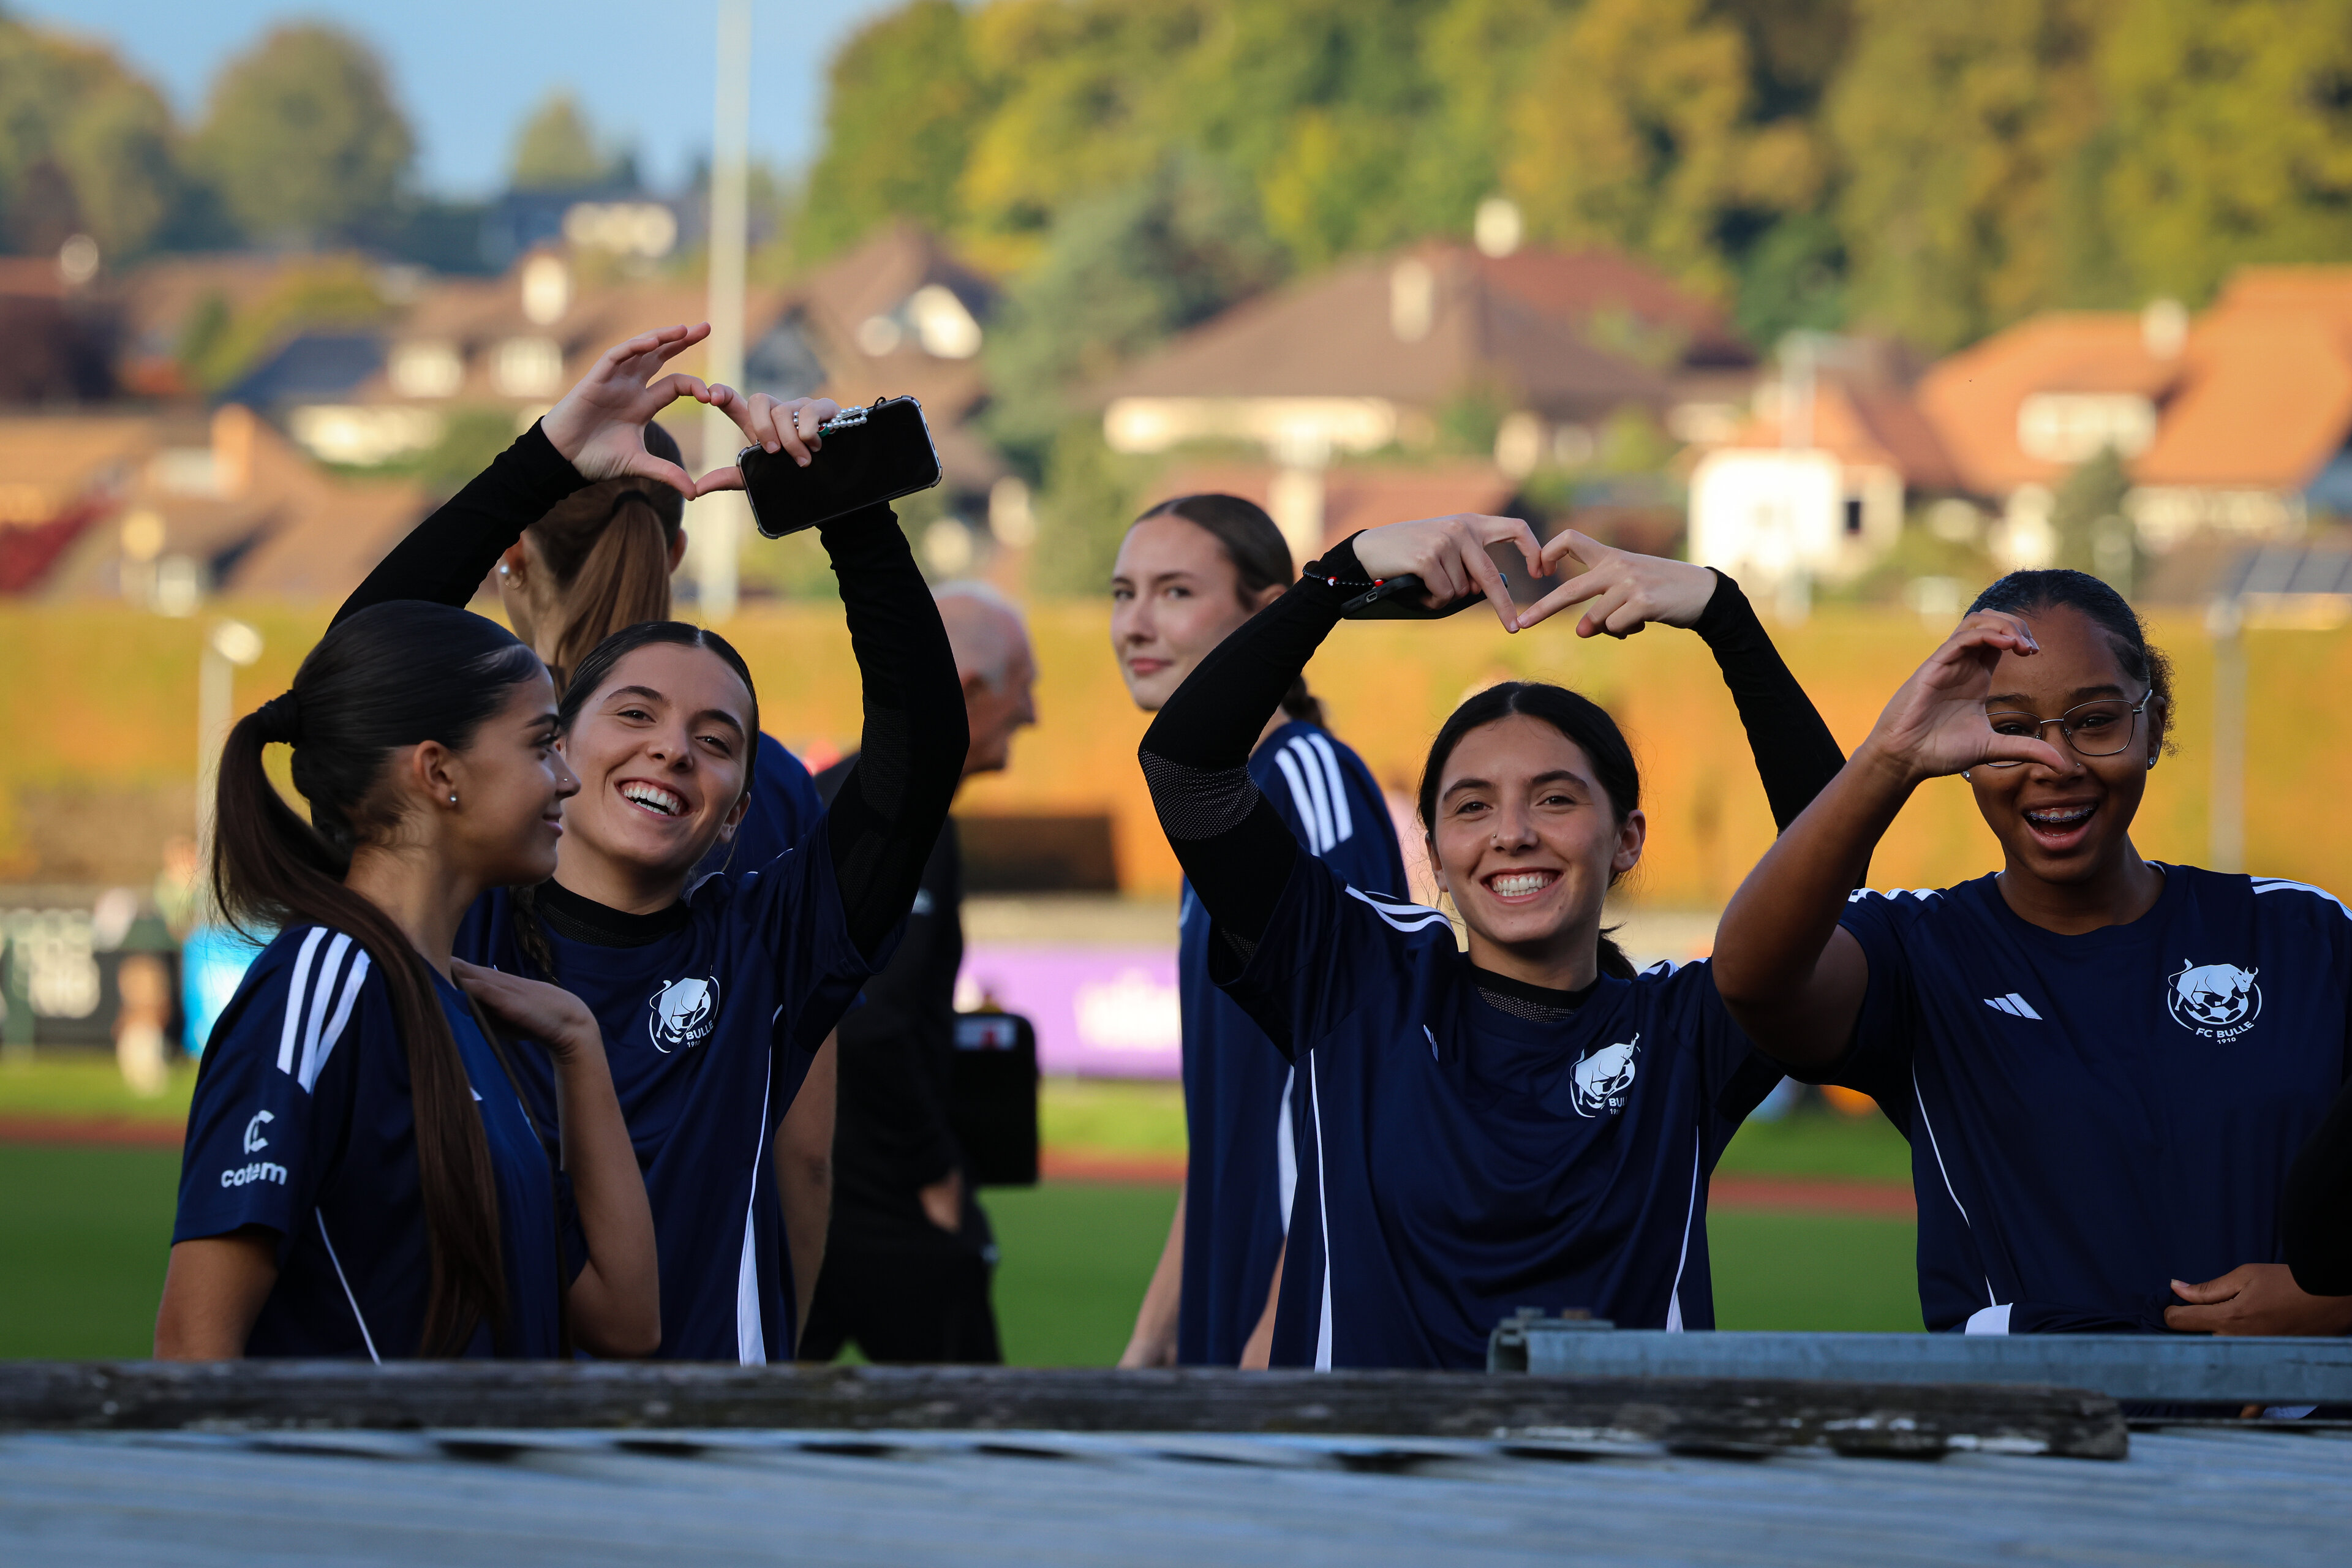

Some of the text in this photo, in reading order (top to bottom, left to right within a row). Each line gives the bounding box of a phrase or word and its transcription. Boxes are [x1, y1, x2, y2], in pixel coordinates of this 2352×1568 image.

[686, 1020, 714, 1039] BULLE
[2196, 1021, 2255, 1038] FC BULLE
